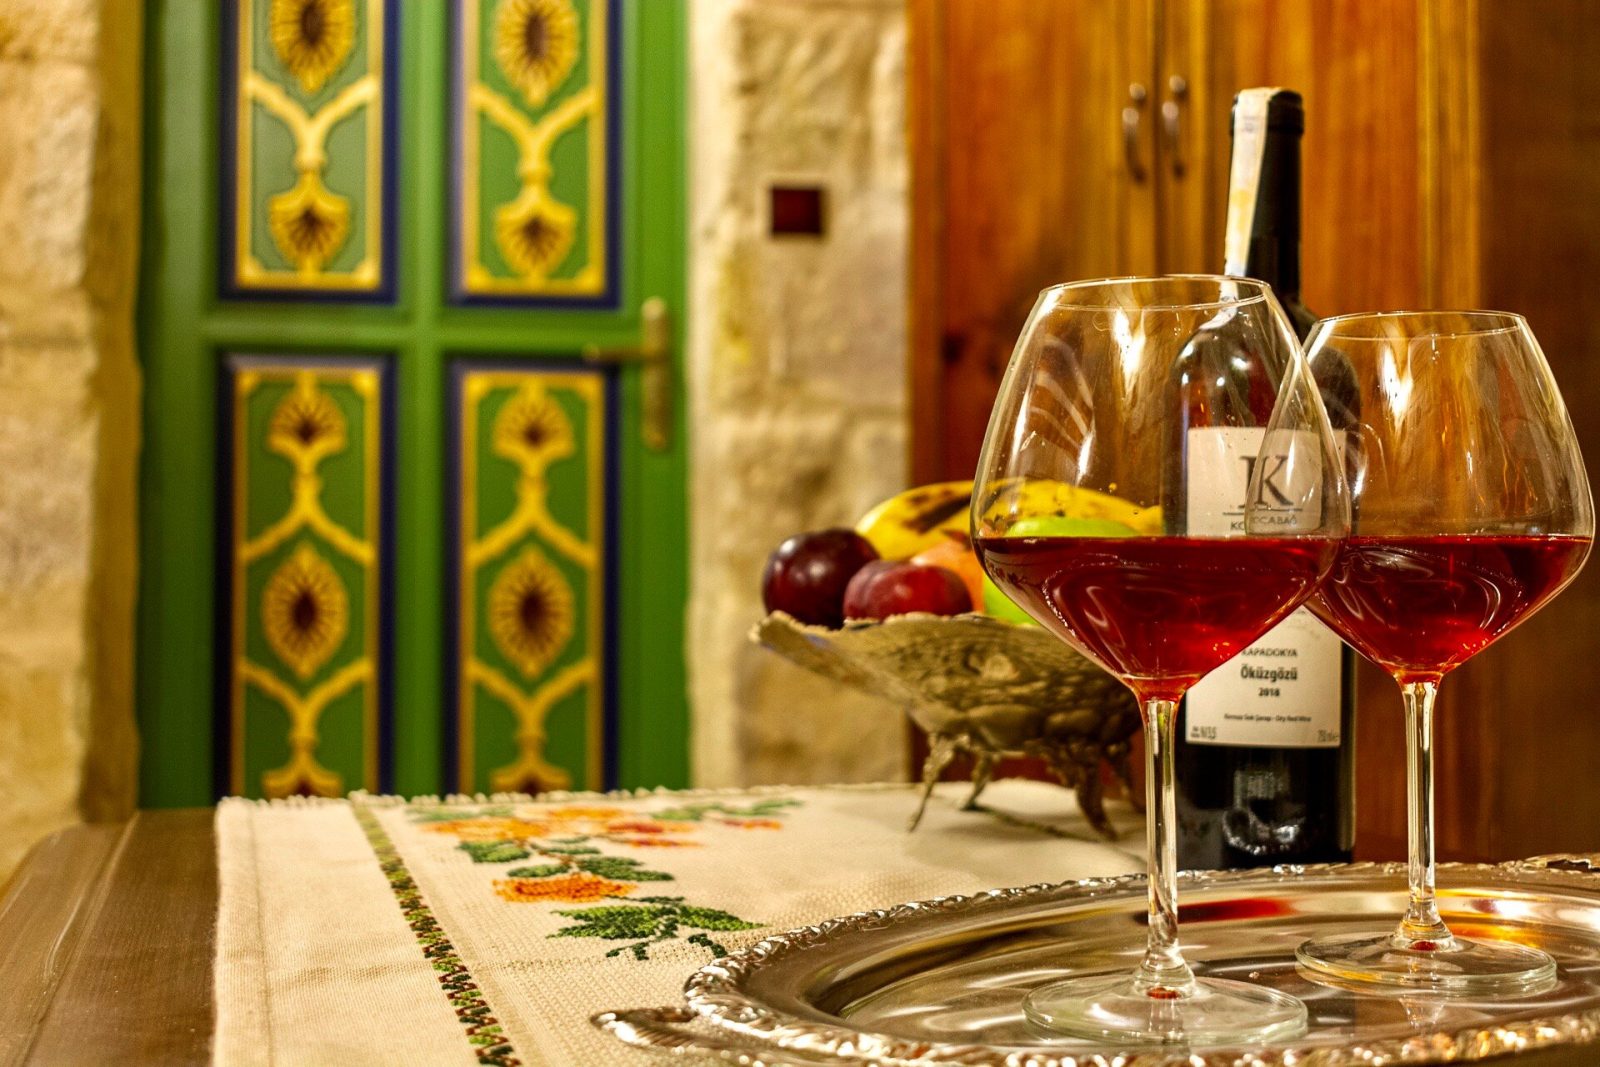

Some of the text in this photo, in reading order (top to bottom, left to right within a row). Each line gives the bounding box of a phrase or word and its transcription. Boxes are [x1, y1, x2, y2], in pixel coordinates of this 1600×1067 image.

[1239, 455, 1294, 509] K
[1241, 648, 1298, 657] KAPADOKYA
[1240, 664, 1298, 682] Öküzgözü
[1258, 687, 1281, 697] 2018
